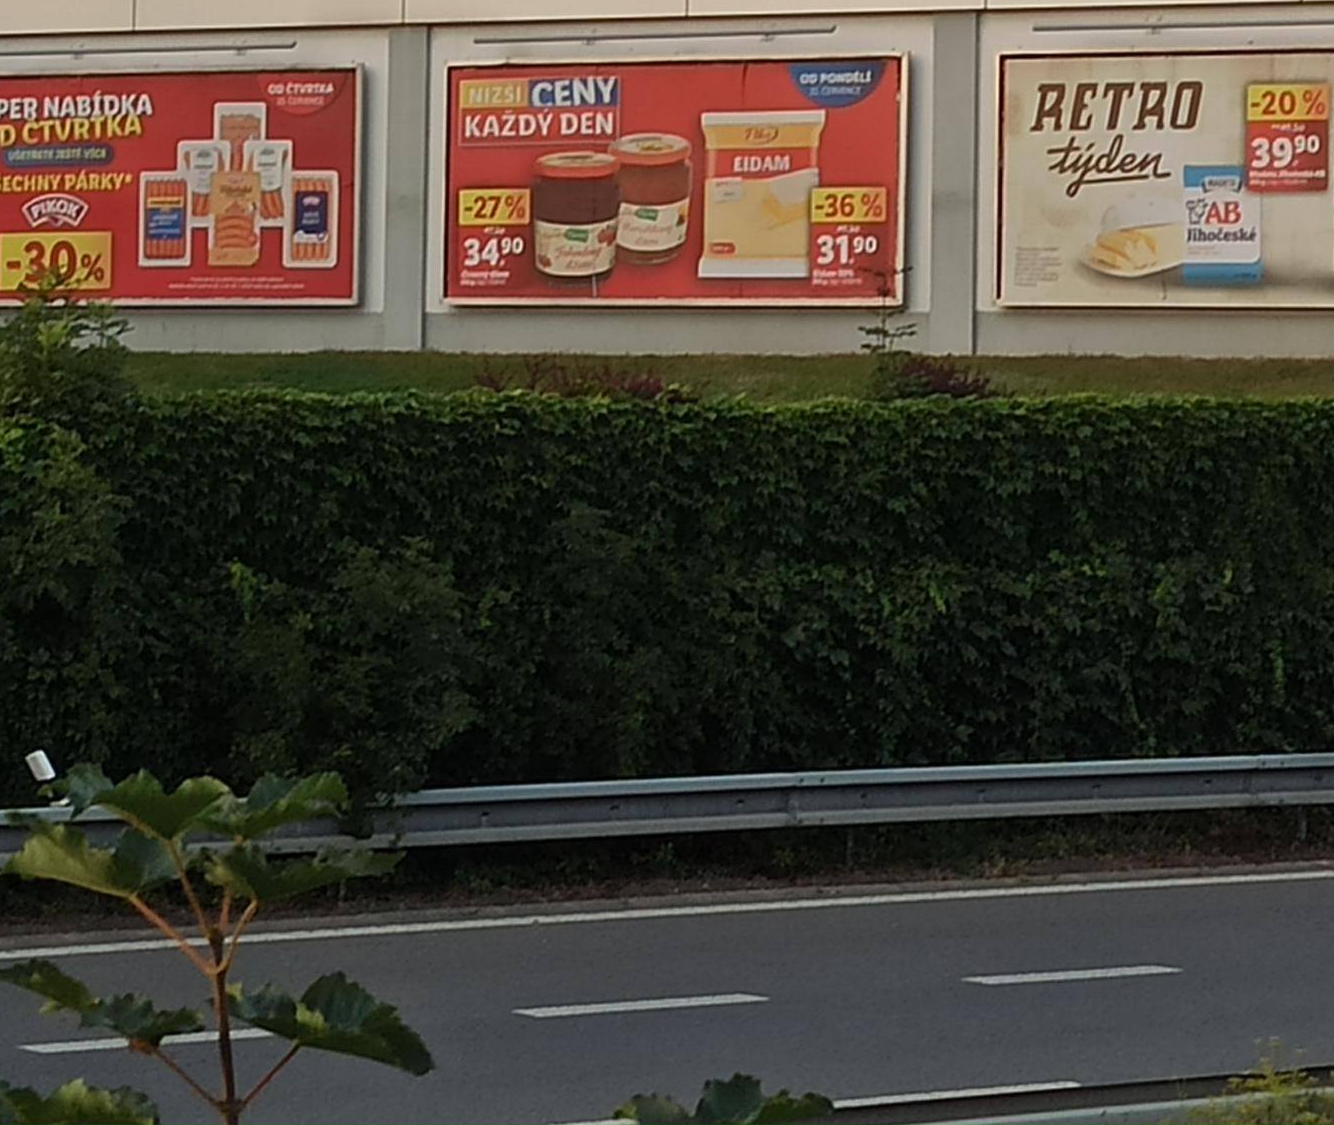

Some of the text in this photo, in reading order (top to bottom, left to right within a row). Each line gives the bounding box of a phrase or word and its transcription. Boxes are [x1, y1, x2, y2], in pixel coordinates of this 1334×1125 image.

[43, 90, 153, 118] NABÍDKA
[531, 76, 617, 107] CENY
[1251, 90, 1296, 115] -20
[1030, 81, 1203, 131] RETRO
[22, 114, 142, 144] ČTVRTKA
[465, 108, 613, 137] KAŽDÝ DEN
[734, 155, 790, 172] EIDAM
[1047, 134, 1171, 198] týden
[31, 198, 78, 219] PIKOK
[815, 194, 855, 217] -36
[1205, 201, 1242, 224] AB
[1186, 226, 1257, 243] Jihočeské
